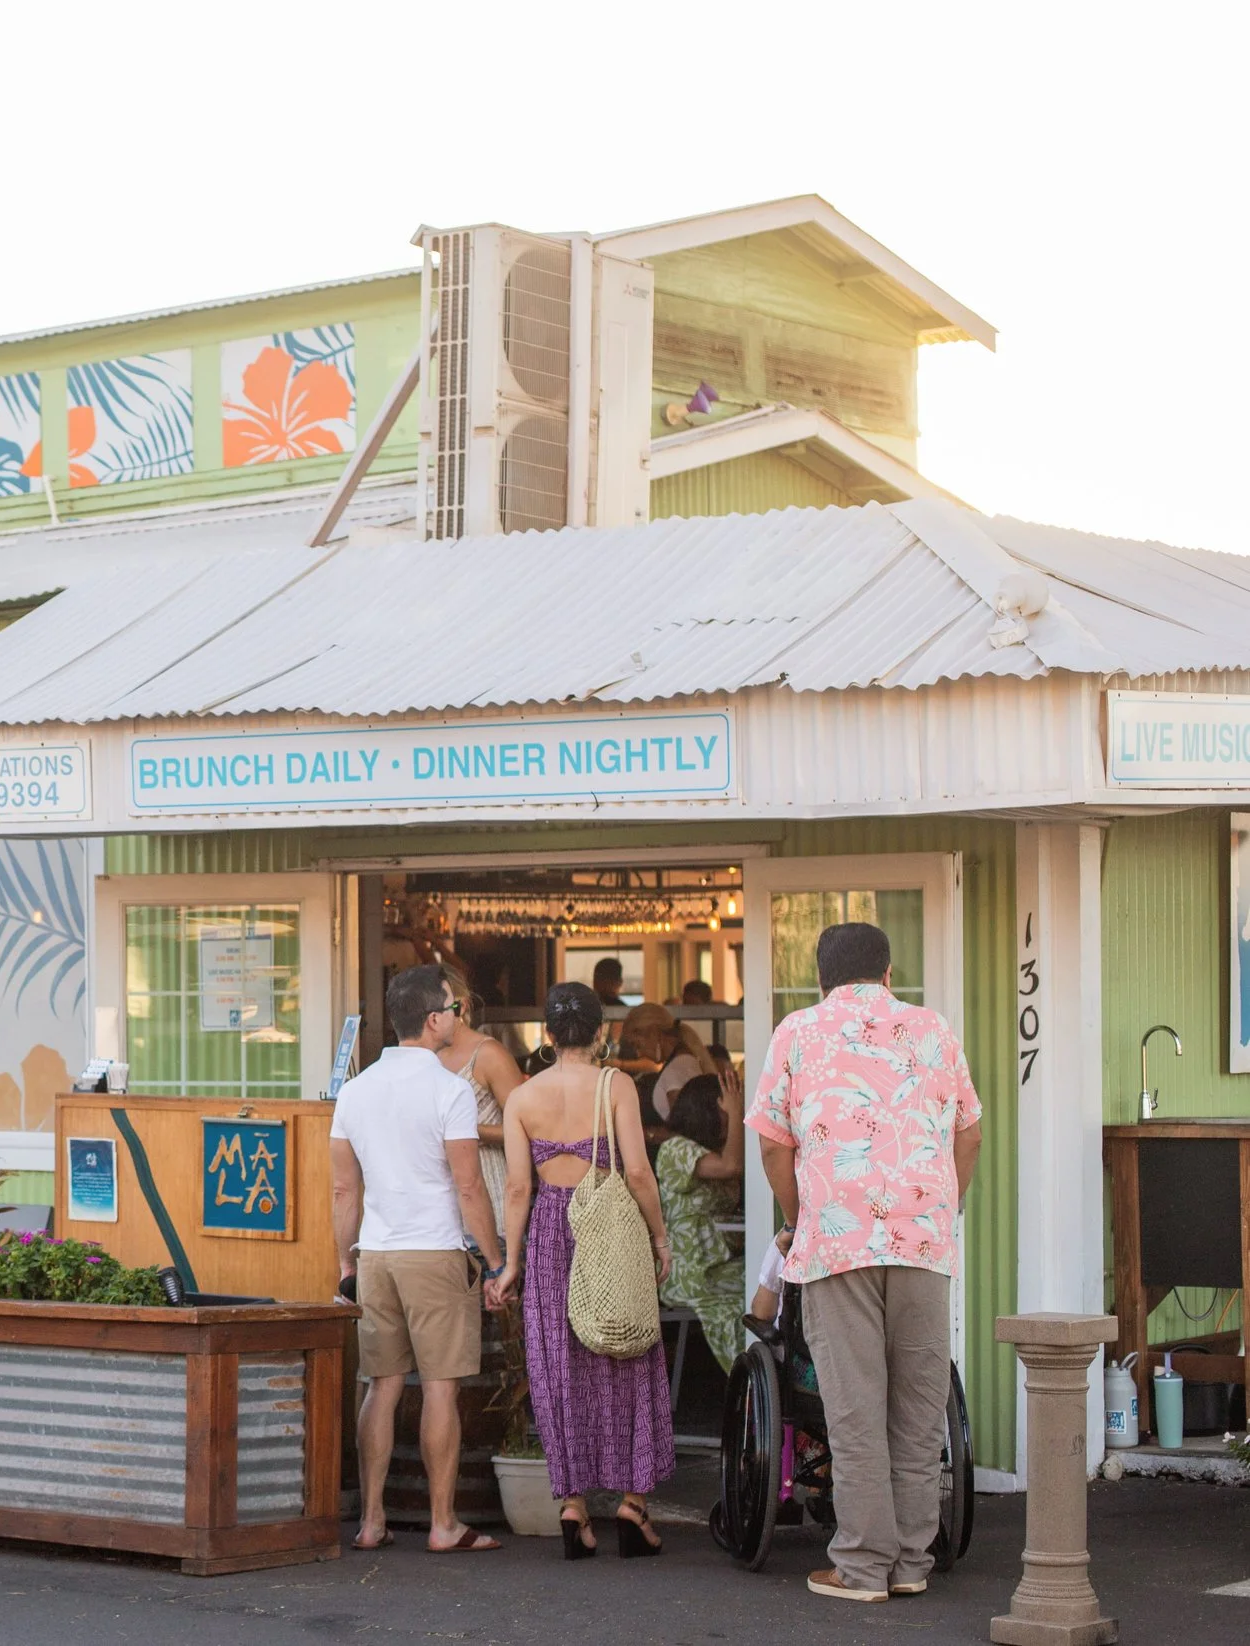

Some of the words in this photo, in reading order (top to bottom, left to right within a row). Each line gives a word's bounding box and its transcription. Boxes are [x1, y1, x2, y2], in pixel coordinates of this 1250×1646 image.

[139, 754, 274, 789] BRUNCH
[286, 749, 380, 784] DAILY
[413, 742, 546, 780] DINNER
[559, 735, 718, 775] NIGHTLY
[1121, 721, 1173, 762] LIVE
[1019, 912, 1040, 1085] 1307
